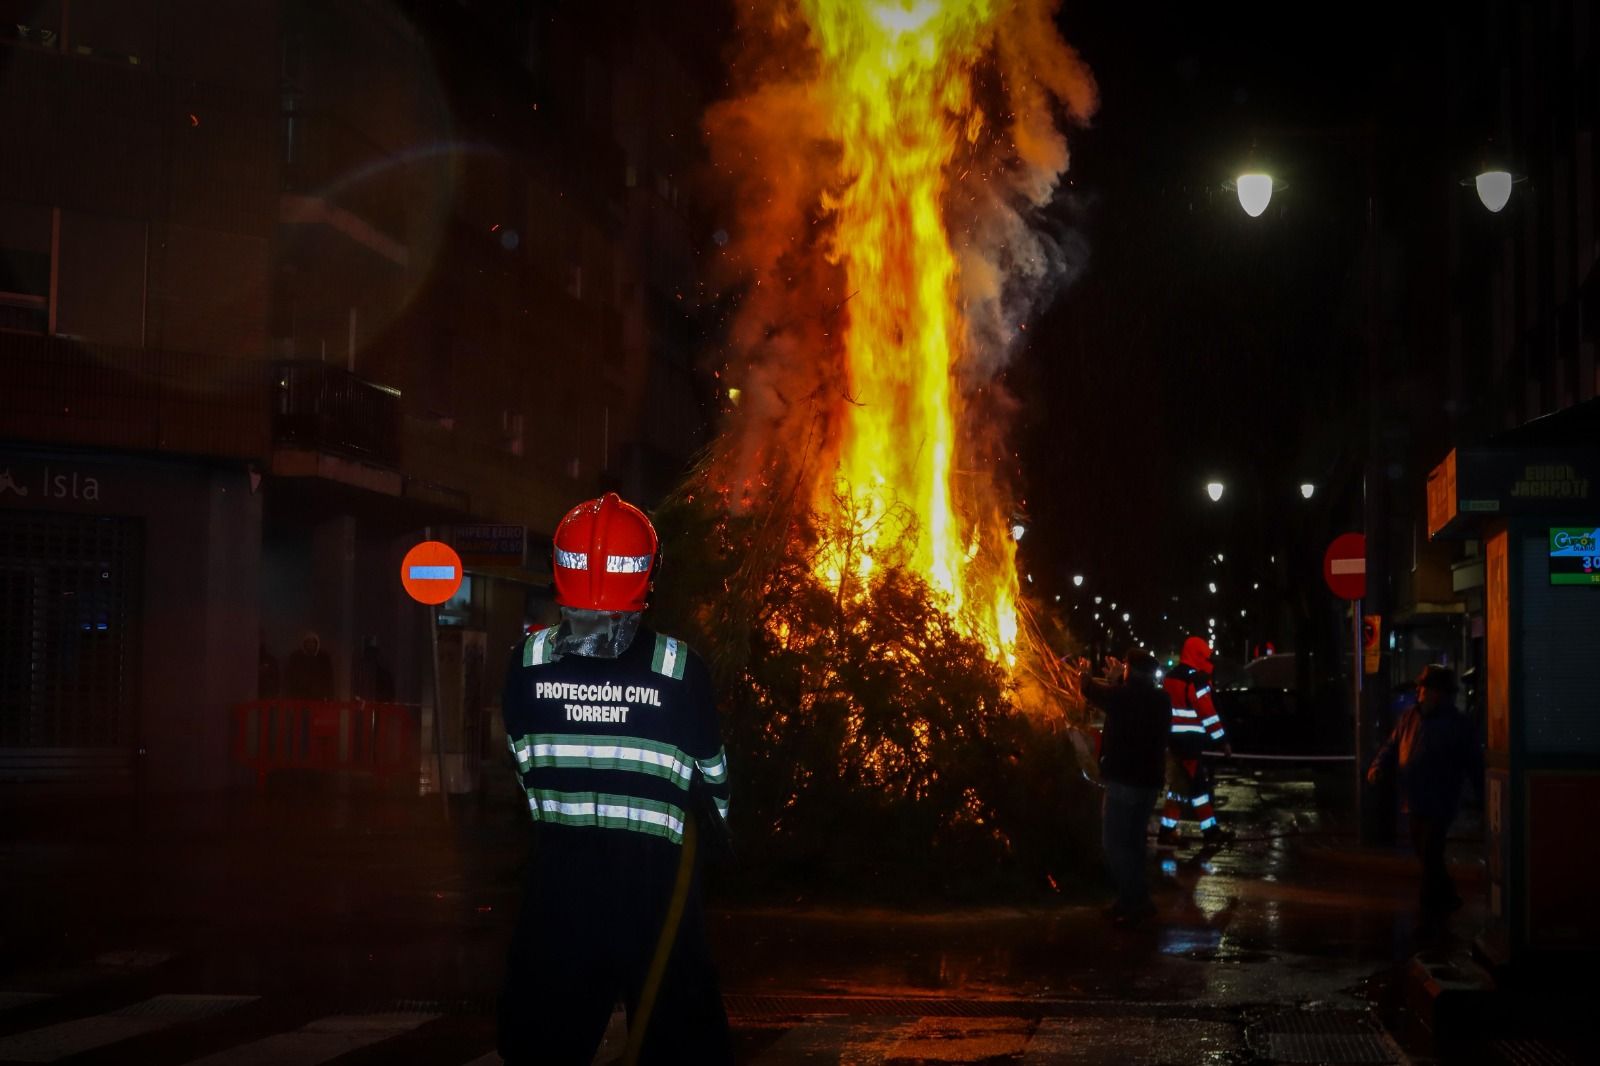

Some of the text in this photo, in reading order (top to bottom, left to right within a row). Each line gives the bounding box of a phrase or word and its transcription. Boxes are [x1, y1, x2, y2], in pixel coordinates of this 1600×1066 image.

[43, 465, 99, 501] Isla
[535, 681, 662, 707] PROTECCIÓN CIVIL
[564, 704, 630, 723] TORRENT
